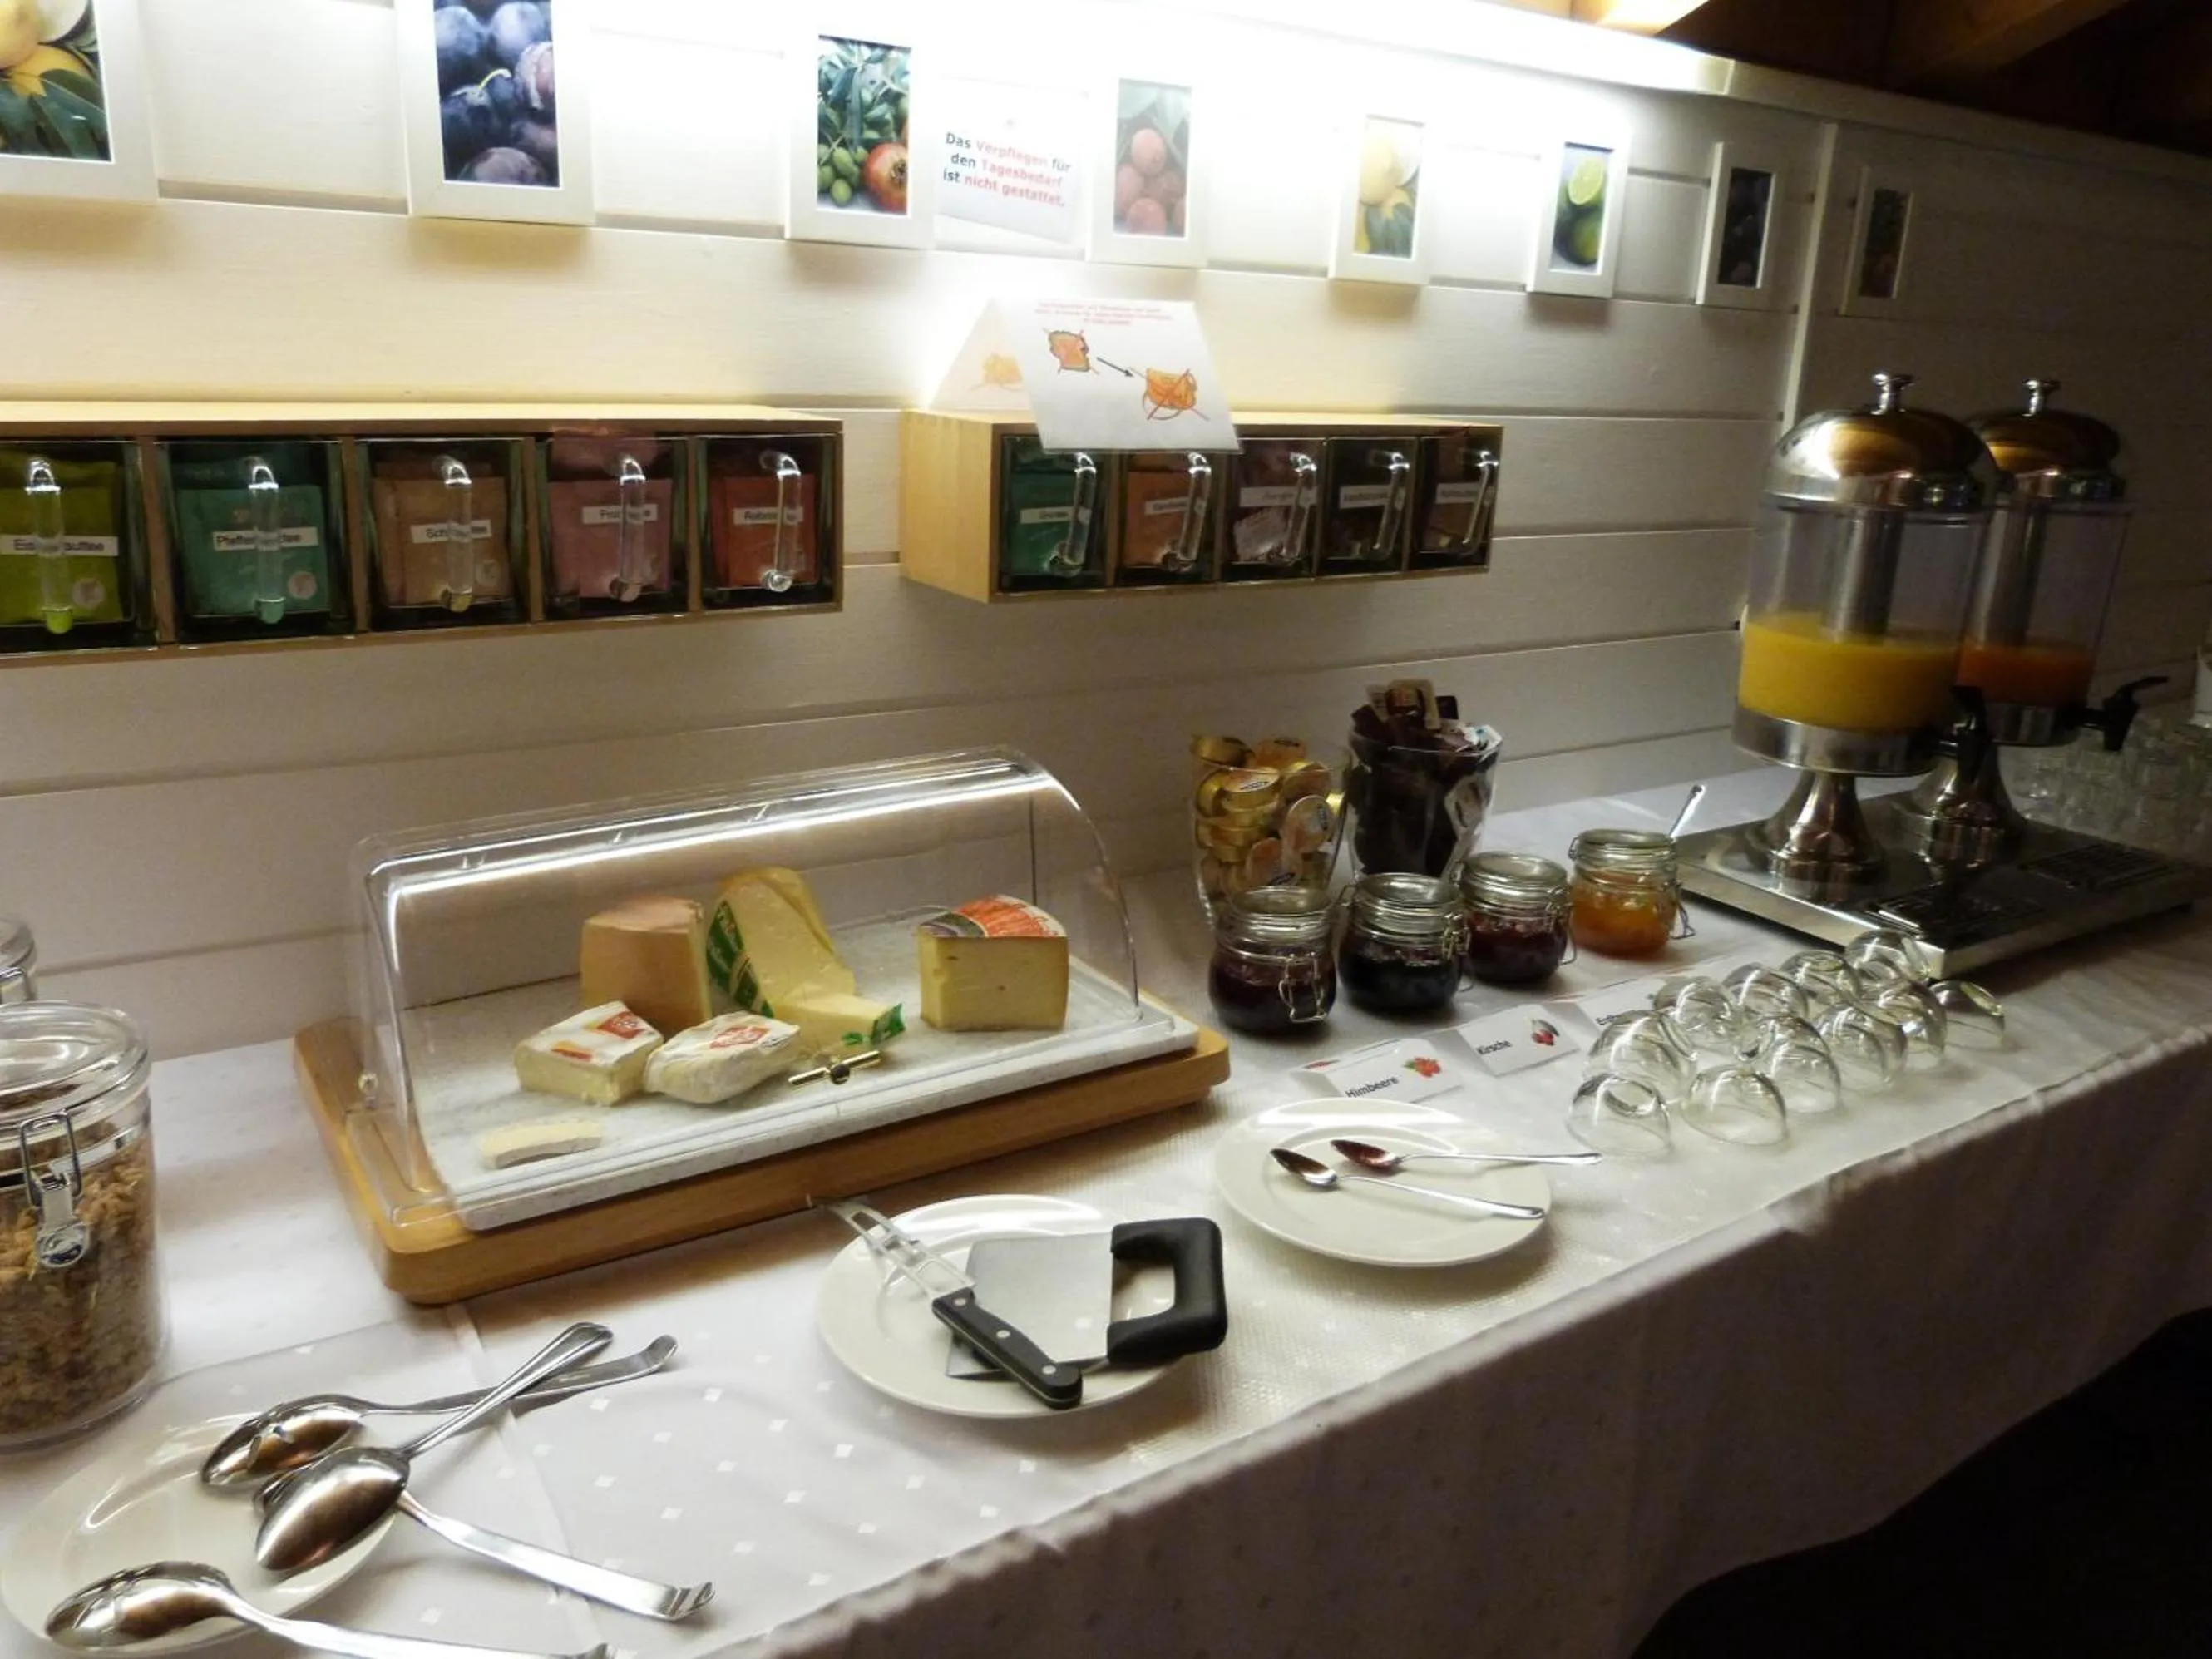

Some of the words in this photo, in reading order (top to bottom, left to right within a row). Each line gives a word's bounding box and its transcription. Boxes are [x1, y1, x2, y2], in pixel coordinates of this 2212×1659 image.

[946, 131, 971, 149] Das
[976, 140, 1049, 166] Verpflegen
[943, 167, 960, 183] ist
[965, 175, 998, 192] nicht
[1002, 184, 1065, 207] gestattet.
[950, 153, 976, 169] den
[981, 158, 1064, 187] Tagesbedarf
[1345, 1076, 1400, 1098] Himbeere
